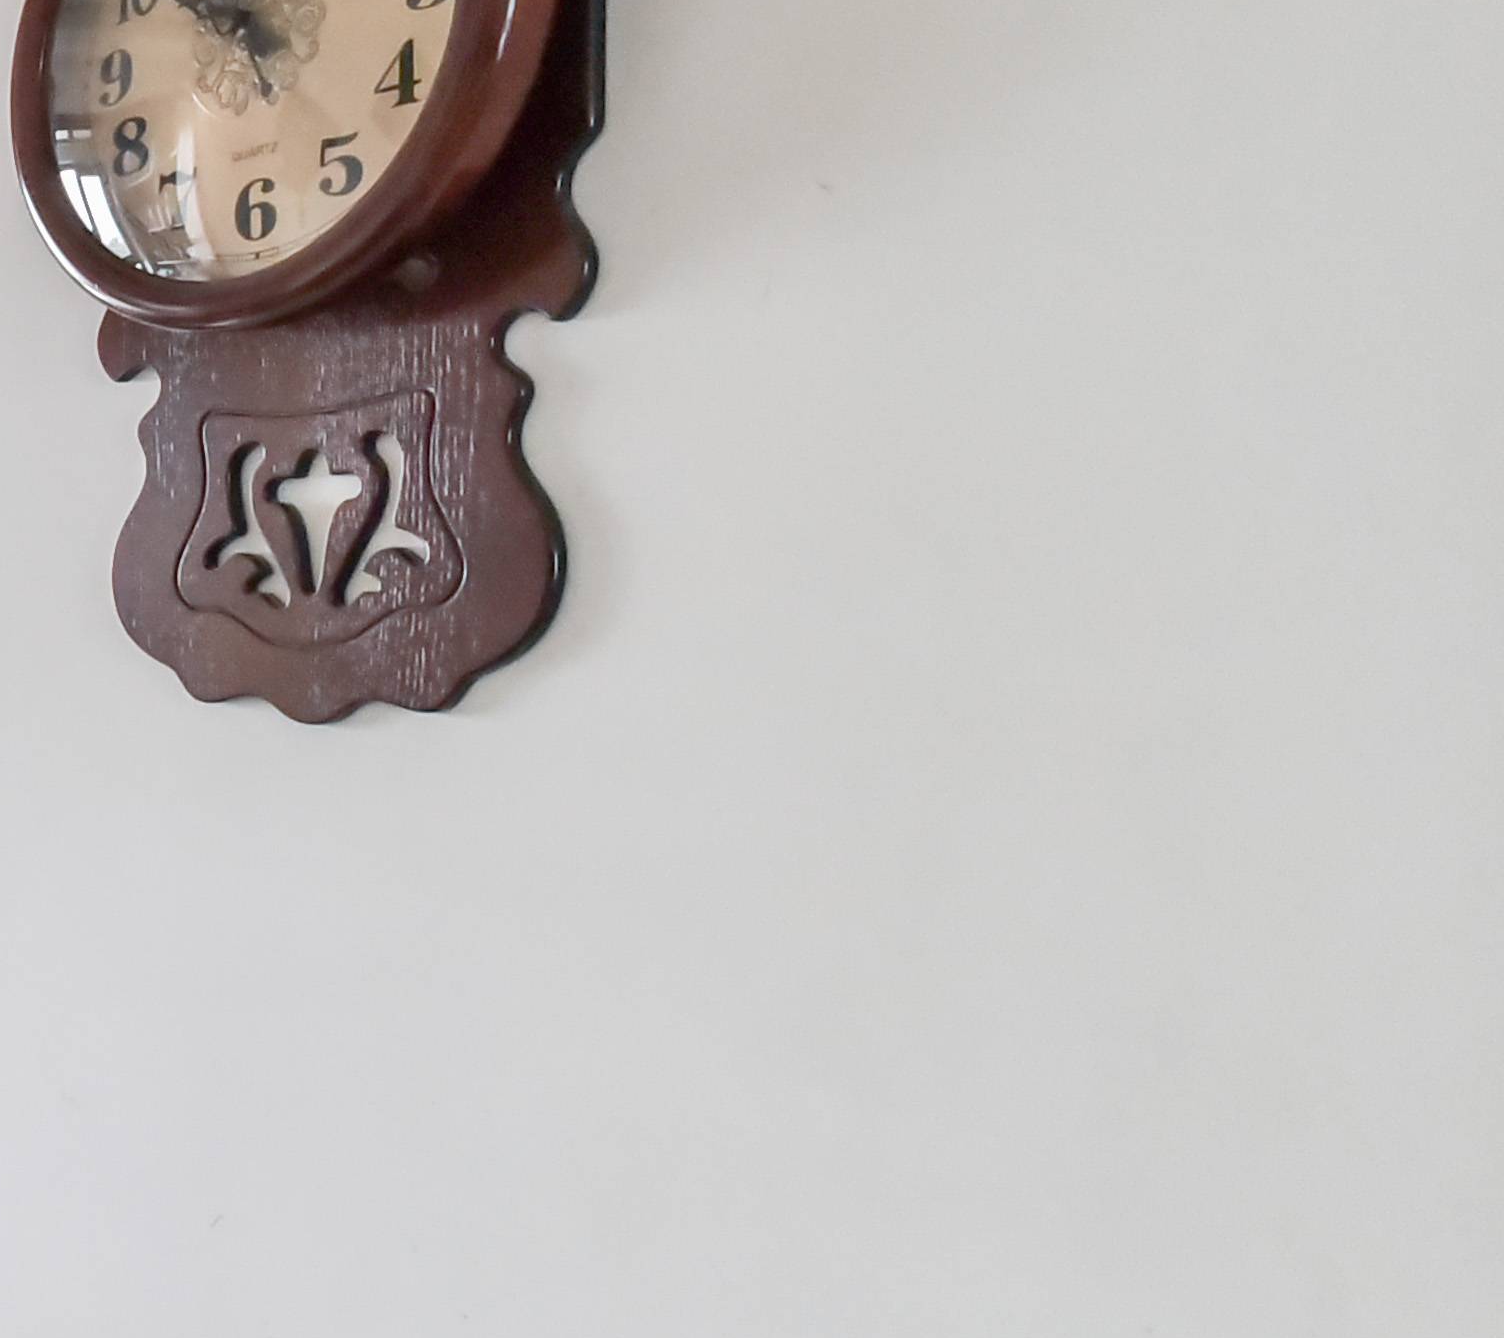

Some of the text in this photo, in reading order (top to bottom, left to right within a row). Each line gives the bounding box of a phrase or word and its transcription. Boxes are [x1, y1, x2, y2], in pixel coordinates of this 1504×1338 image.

[98, 47, 133, 107] 9
[373, 37, 423, 109] 4
[112, 116, 150, 177] 8
[318, 130, 365, 197] 5
[234, 176, 277, 242] 6
